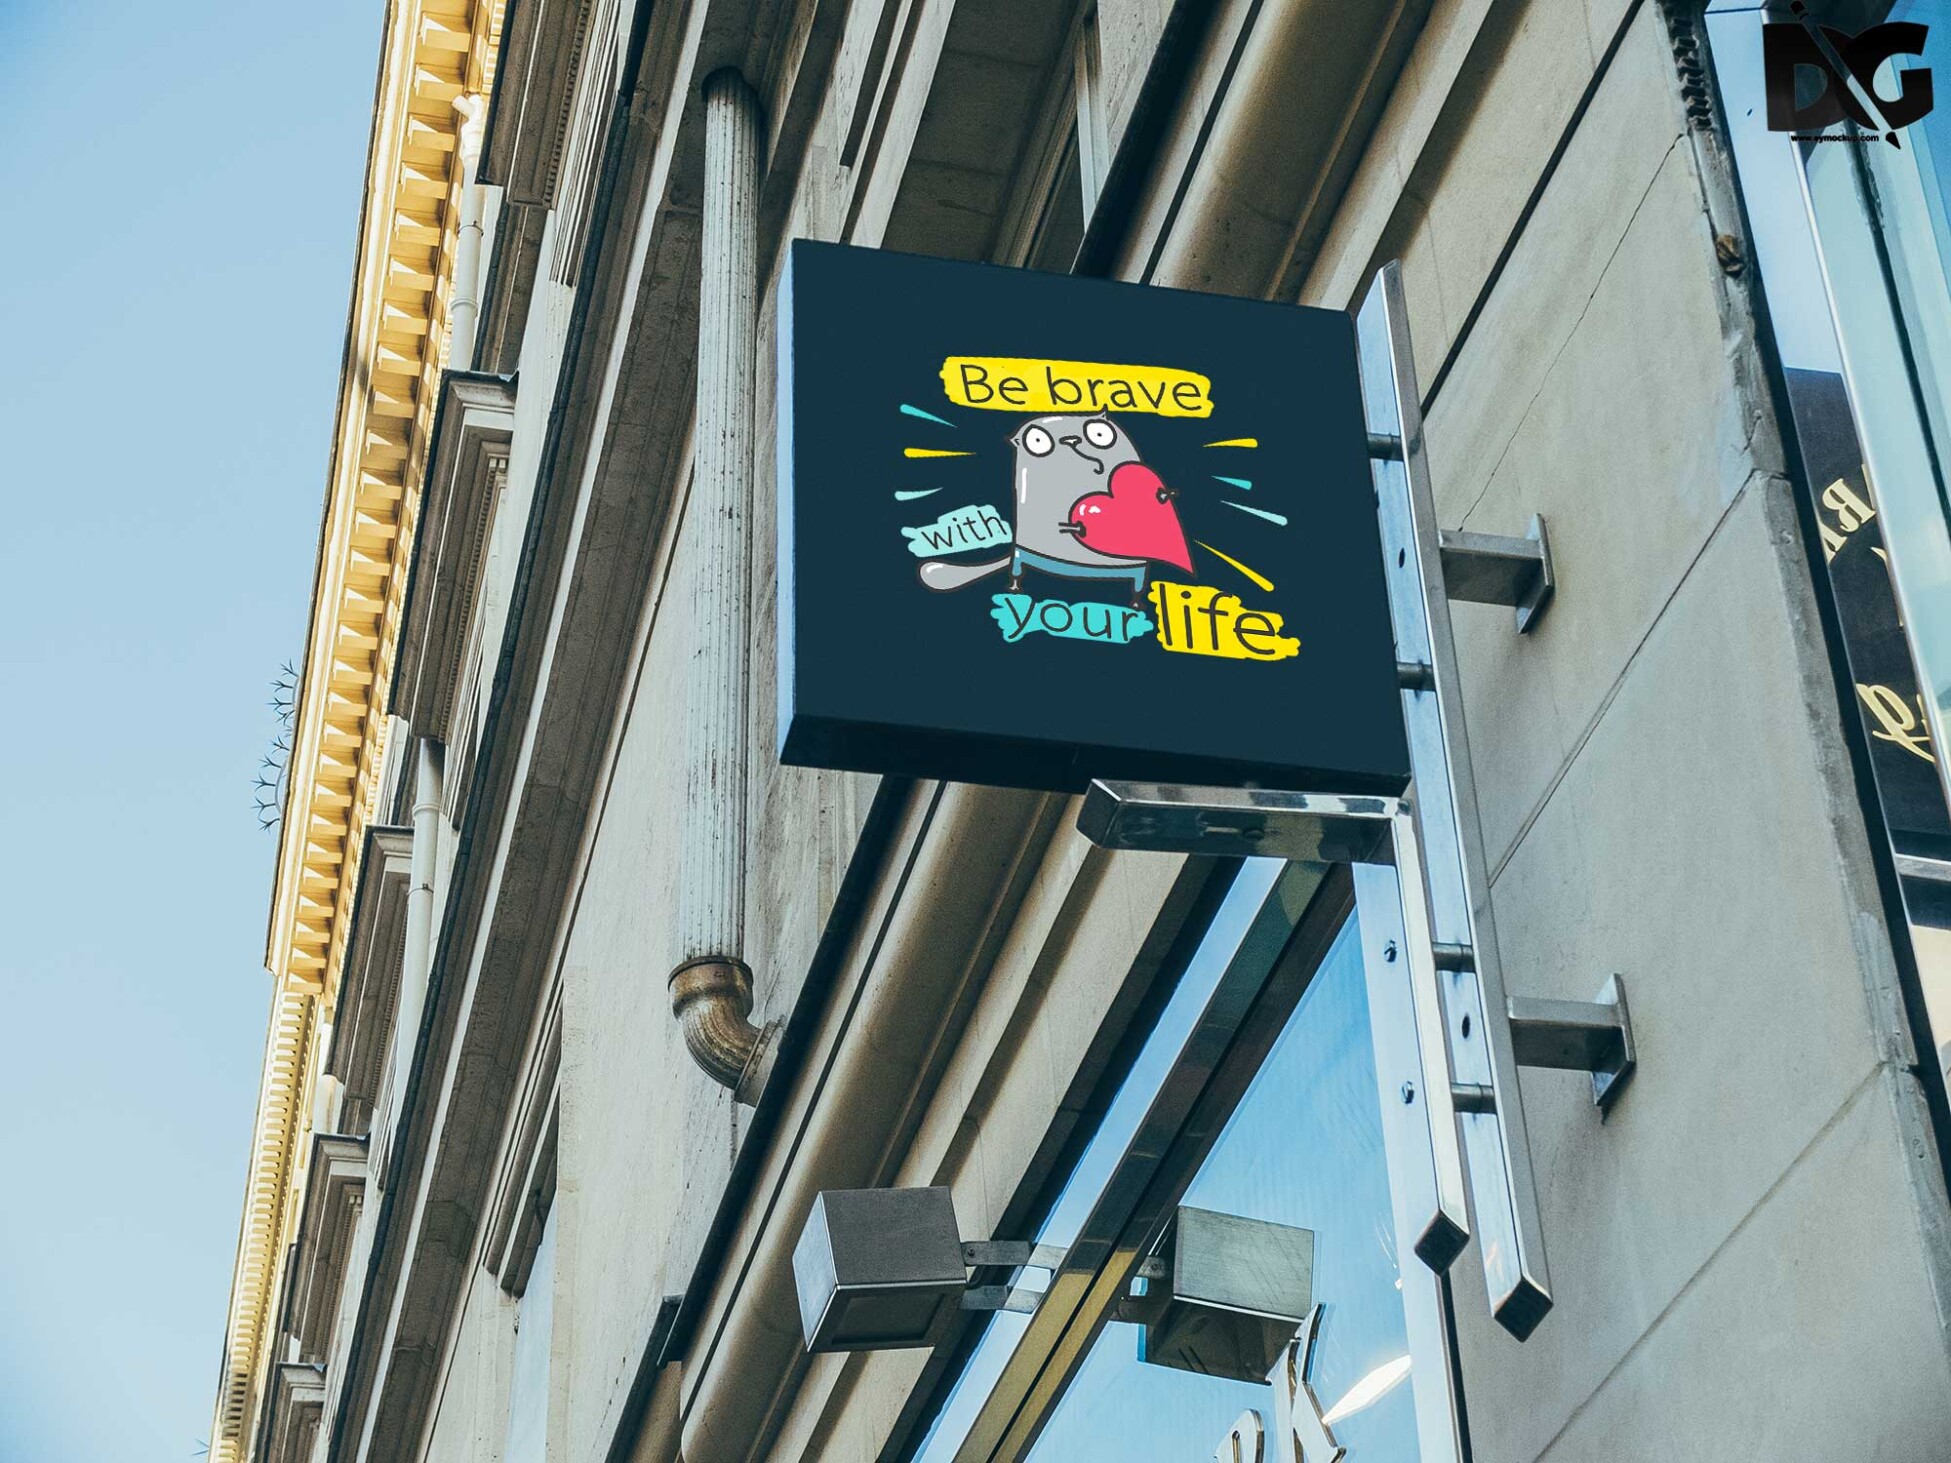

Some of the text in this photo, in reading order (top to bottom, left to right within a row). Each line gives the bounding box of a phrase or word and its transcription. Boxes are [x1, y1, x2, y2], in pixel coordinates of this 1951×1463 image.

[959, 364, 1203, 411] Be brave
[920, 508, 1006, 551] with
[1003, 583, 1277, 655] your life
